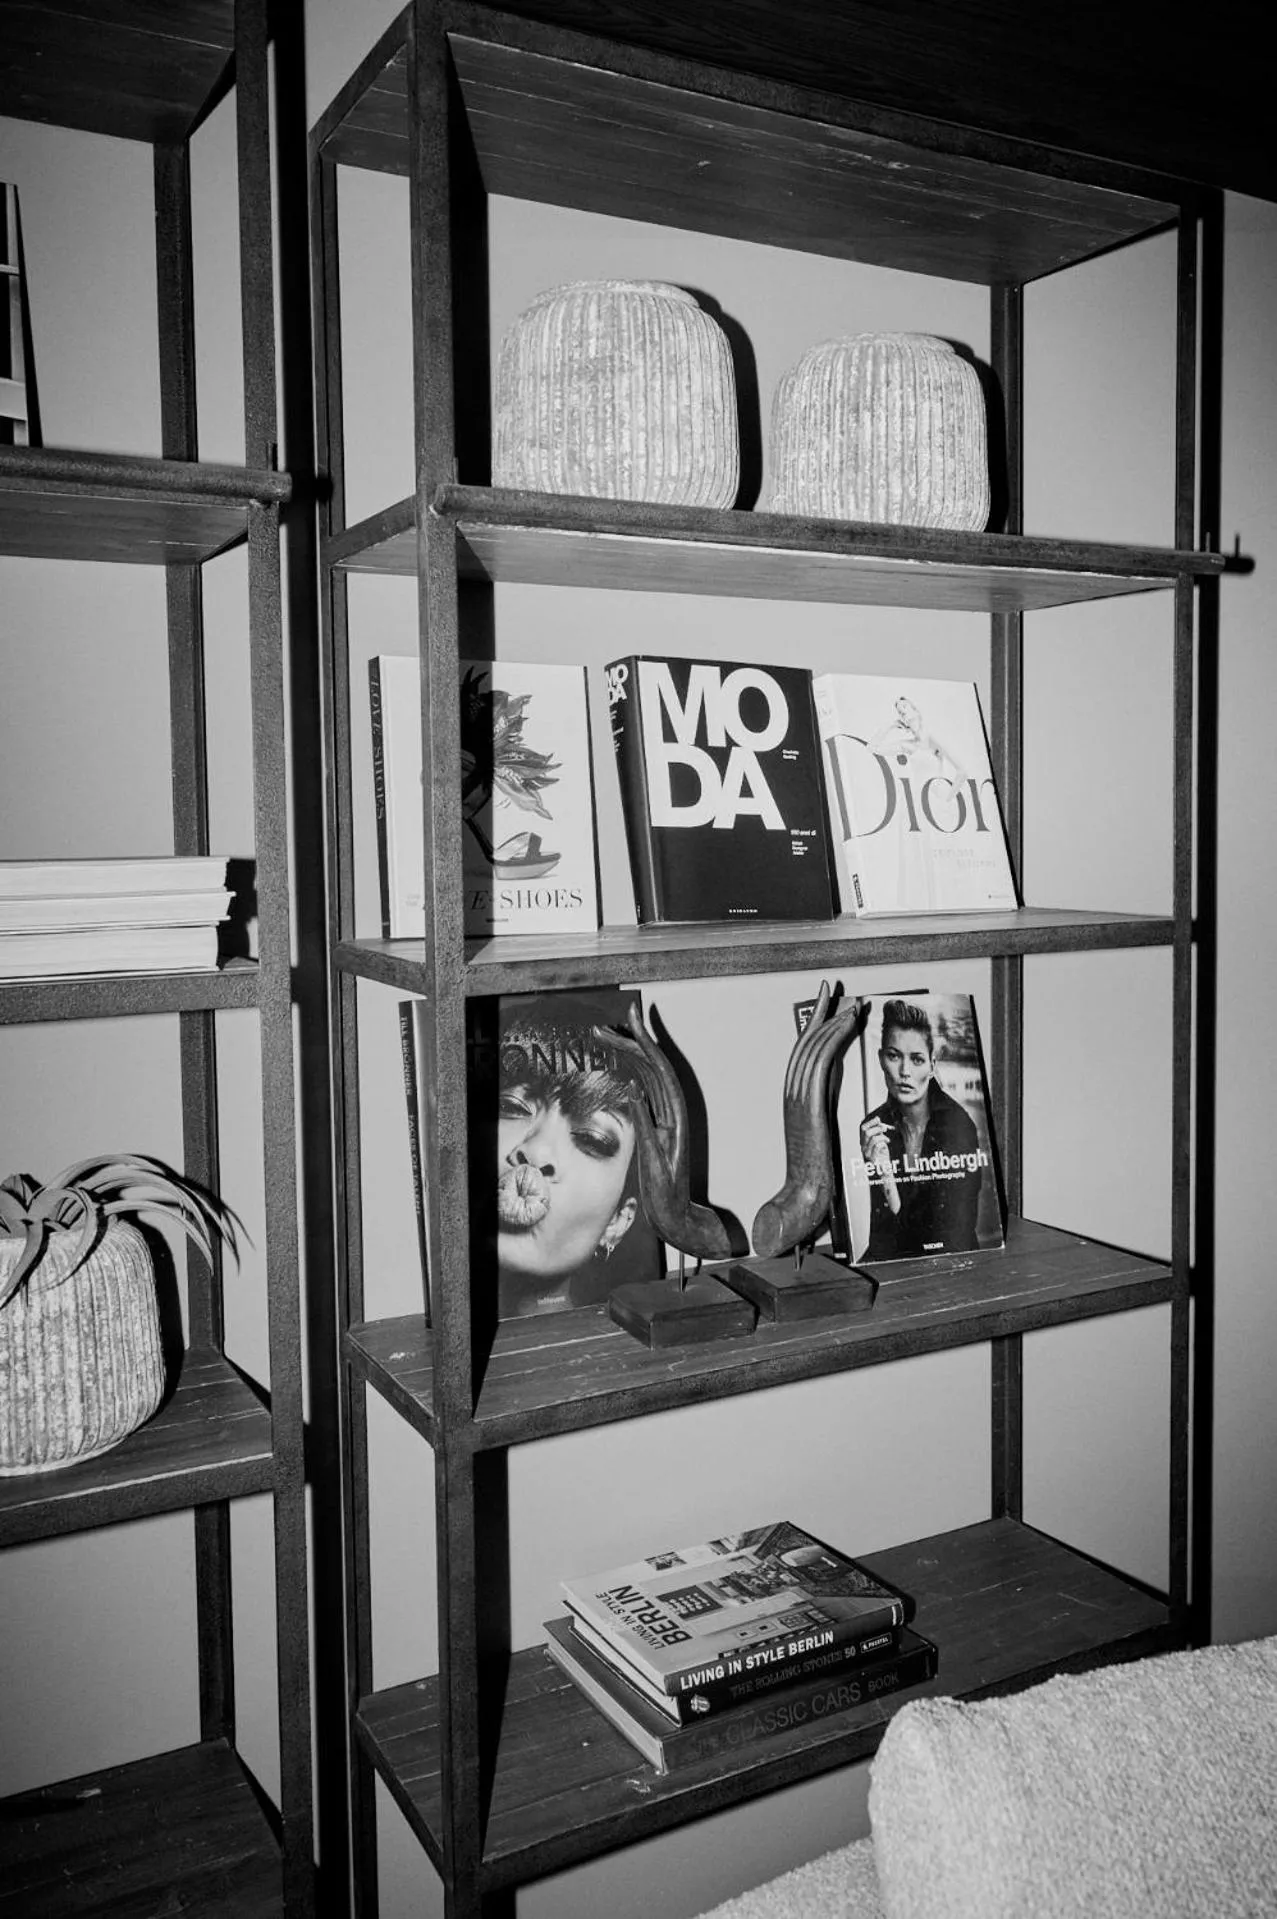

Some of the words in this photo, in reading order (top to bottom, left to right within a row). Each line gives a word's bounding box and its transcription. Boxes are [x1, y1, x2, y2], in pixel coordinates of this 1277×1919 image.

[637, 660, 789, 753] MO
[373, 745, 385, 821] SHOES
[647, 742, 787, 830] DA
[825, 733, 996, 842] Dior
[500, 888, 583, 910] SHOES
[851, 1156, 900, 1177] Peter
[903, 1148, 988, 1172] Lindbergh
[594, 1591, 625, 1616] STYLE
[608, 1584, 693, 1646] BERLIN
[621, 1614, 635, 1626] IN
[632, 1621, 666, 1651] LIVING
[680, 1664, 725, 1691] LIVING
[728, 1659, 743, 1676] IN
[745, 1646, 785, 1670] STYLE
[788, 1631, 835, 1657] BERLIN
[755, 1664, 802, 1691] ROLLING
[844, 1645, 857, 1660] 50
[725, 1701, 808, 1744] CLASSIC
[811, 1682, 863, 1715] CARS
[867, 1672, 900, 1693] BOOK
